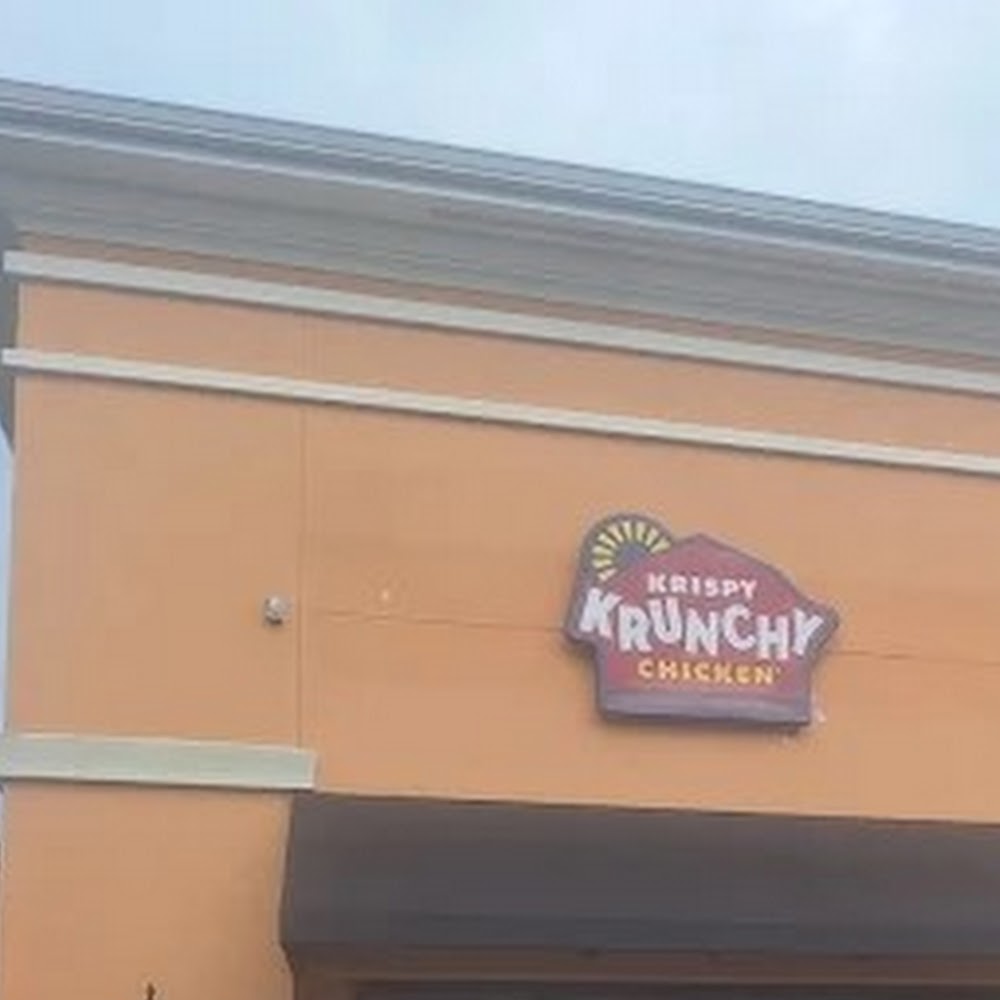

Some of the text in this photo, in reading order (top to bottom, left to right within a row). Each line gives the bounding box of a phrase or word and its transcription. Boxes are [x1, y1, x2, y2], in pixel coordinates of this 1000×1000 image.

[647, 573, 757, 598] KRISPY
[579, 587, 824, 661] KRUNCHY
[637, 660, 775, 685] CHICKEN
